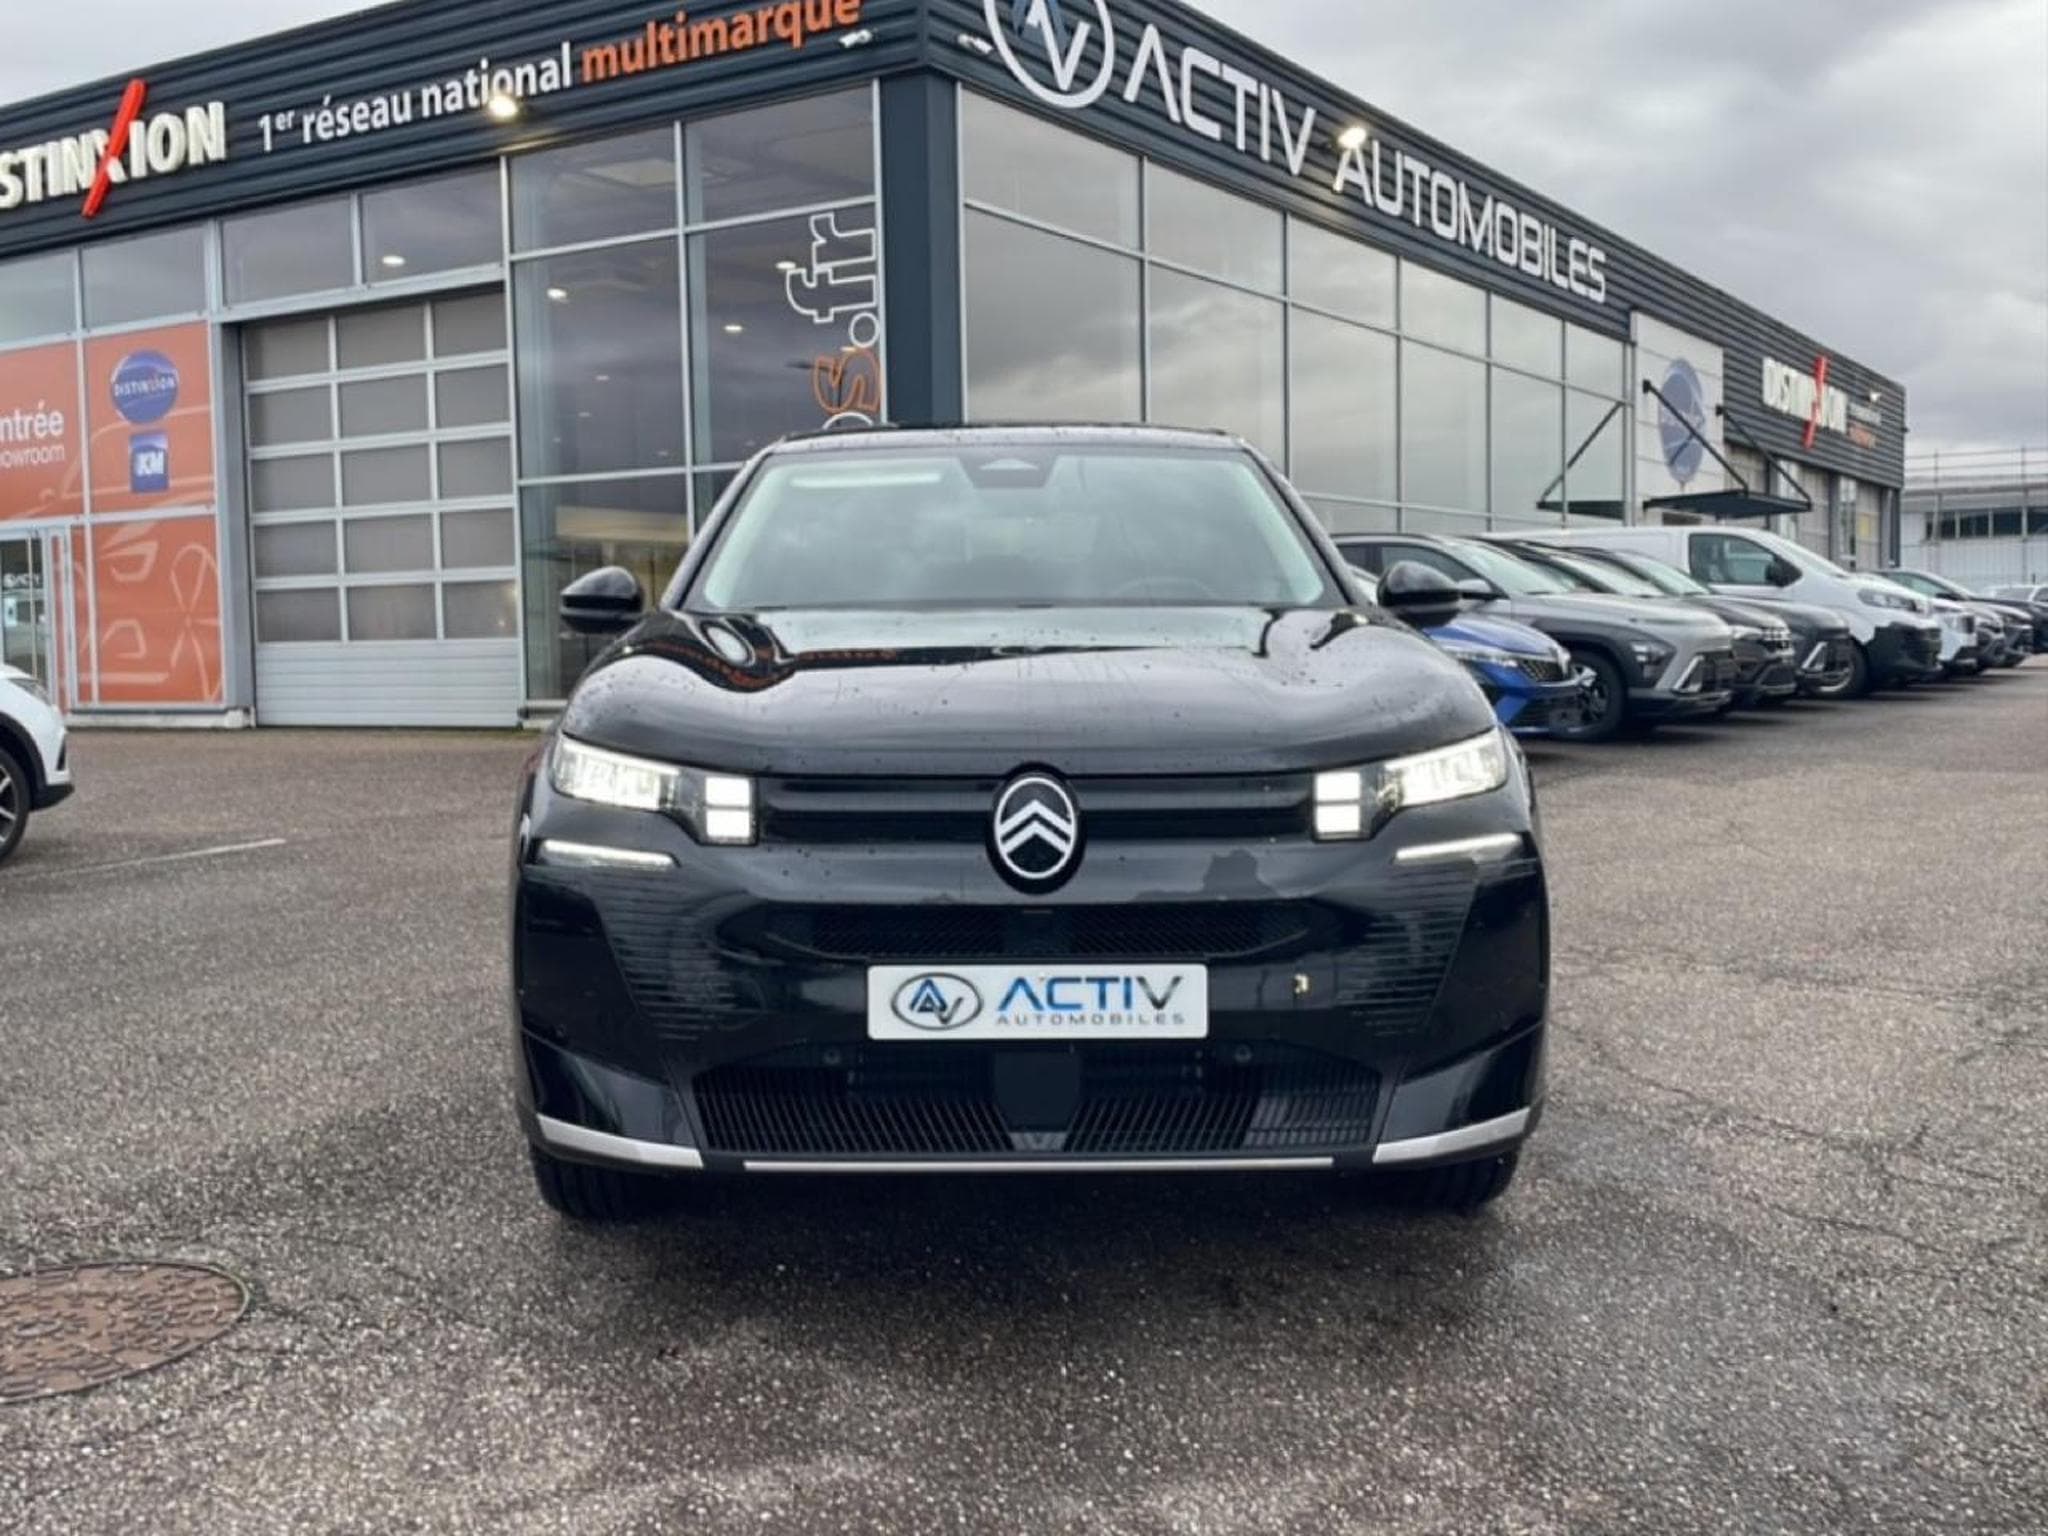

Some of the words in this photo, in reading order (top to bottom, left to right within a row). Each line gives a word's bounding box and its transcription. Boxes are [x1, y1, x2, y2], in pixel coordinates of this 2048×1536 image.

[257, 109, 295, 152] 1er
[302, 94, 411, 144] réseau
[421, 41, 571, 118] national
[581, 0, 860, 83] multimarque
[1123, 24, 1316, 176] ACTIV
[1332, 138, 1606, 302] AUTOMOBILES
[996, 1013, 1185, 1026] AUTOMOBILES
[997, 976, 1183, 1012] ACTIV
